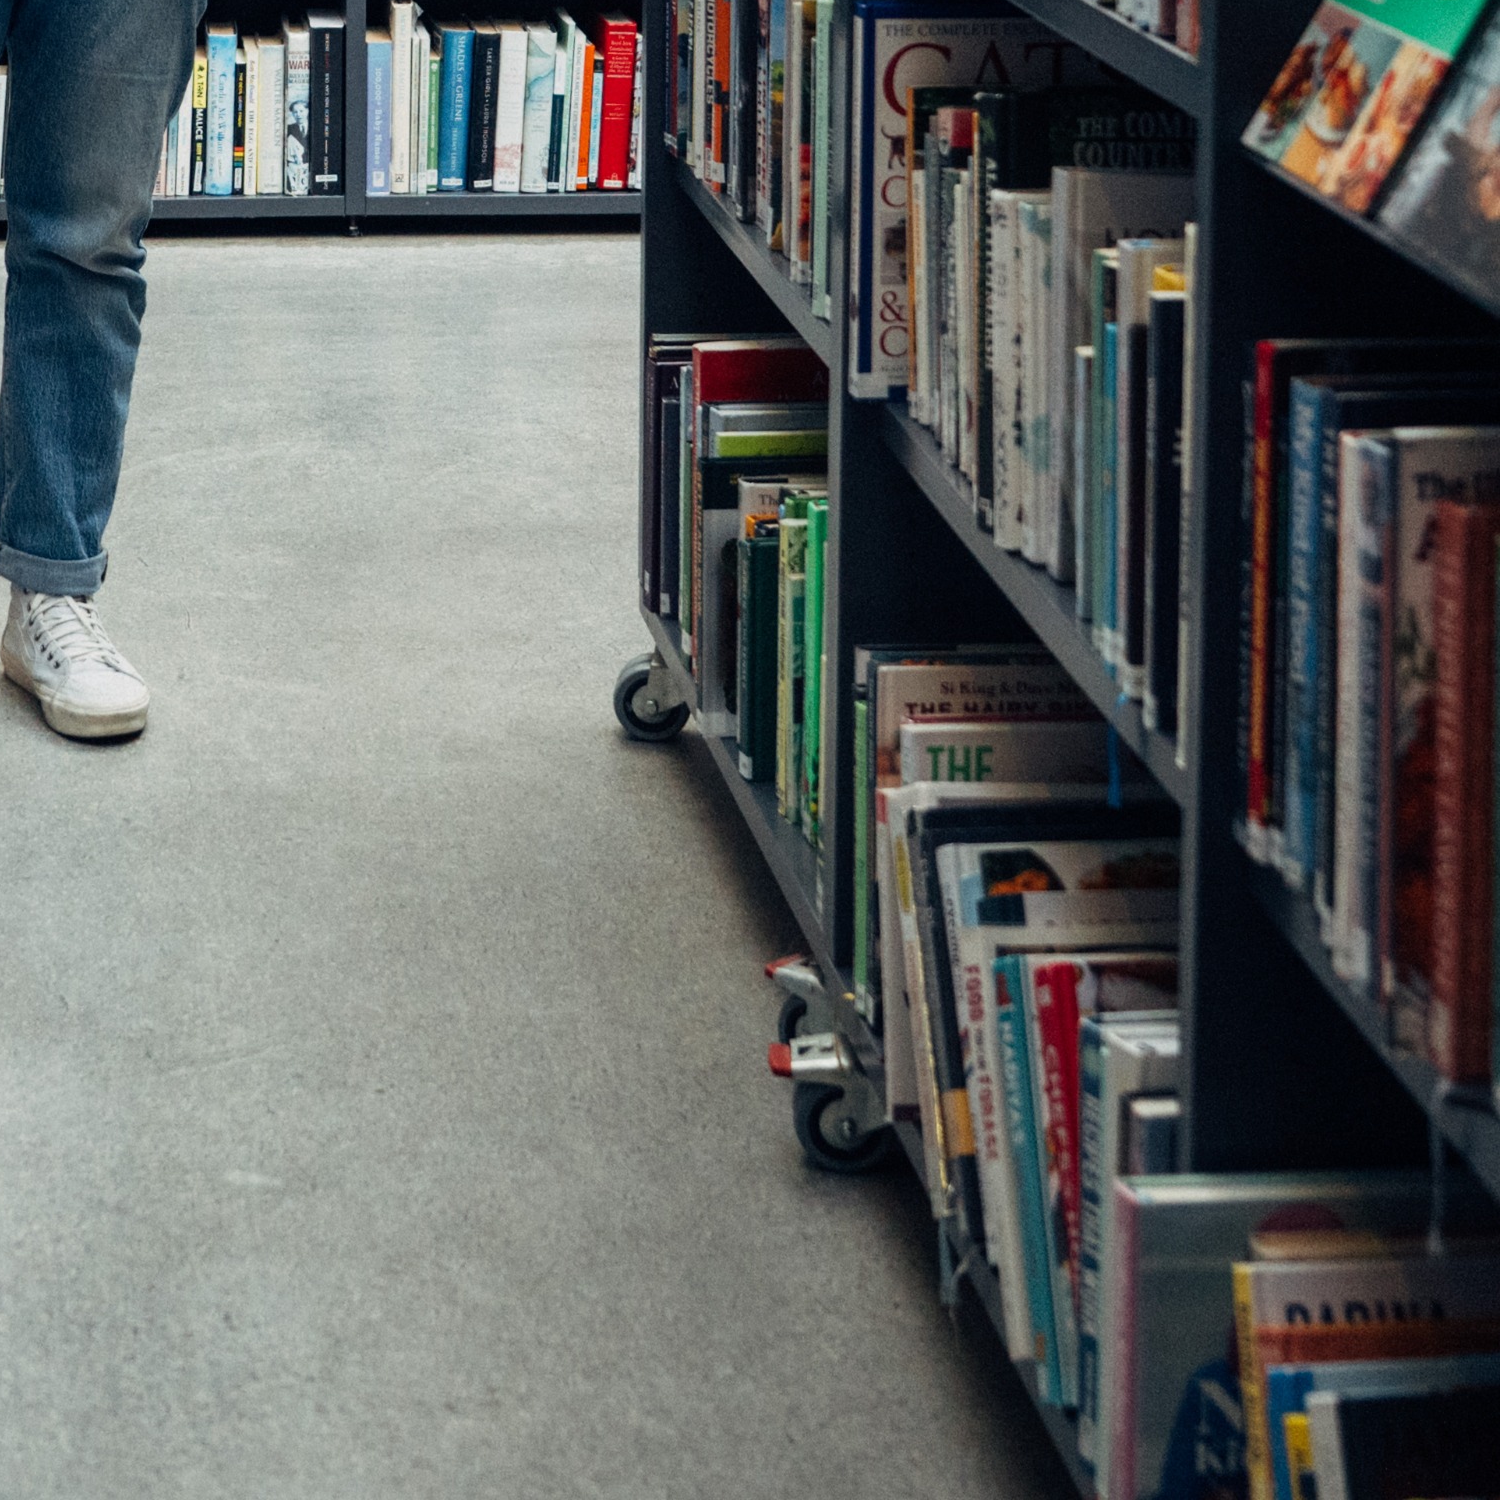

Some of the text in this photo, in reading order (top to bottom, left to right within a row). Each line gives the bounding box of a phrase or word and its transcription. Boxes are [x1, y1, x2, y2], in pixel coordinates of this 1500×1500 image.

[884, 23, 998, 38] THE COMPLETE
[456, 35, 466, 72] SHADES
[273, 68, 283, 147] WALTER MACKEN
[454, 85, 465, 122] GREENE
[195, 108, 204, 141] MALICE
[926, 744, 994, 782] THE
